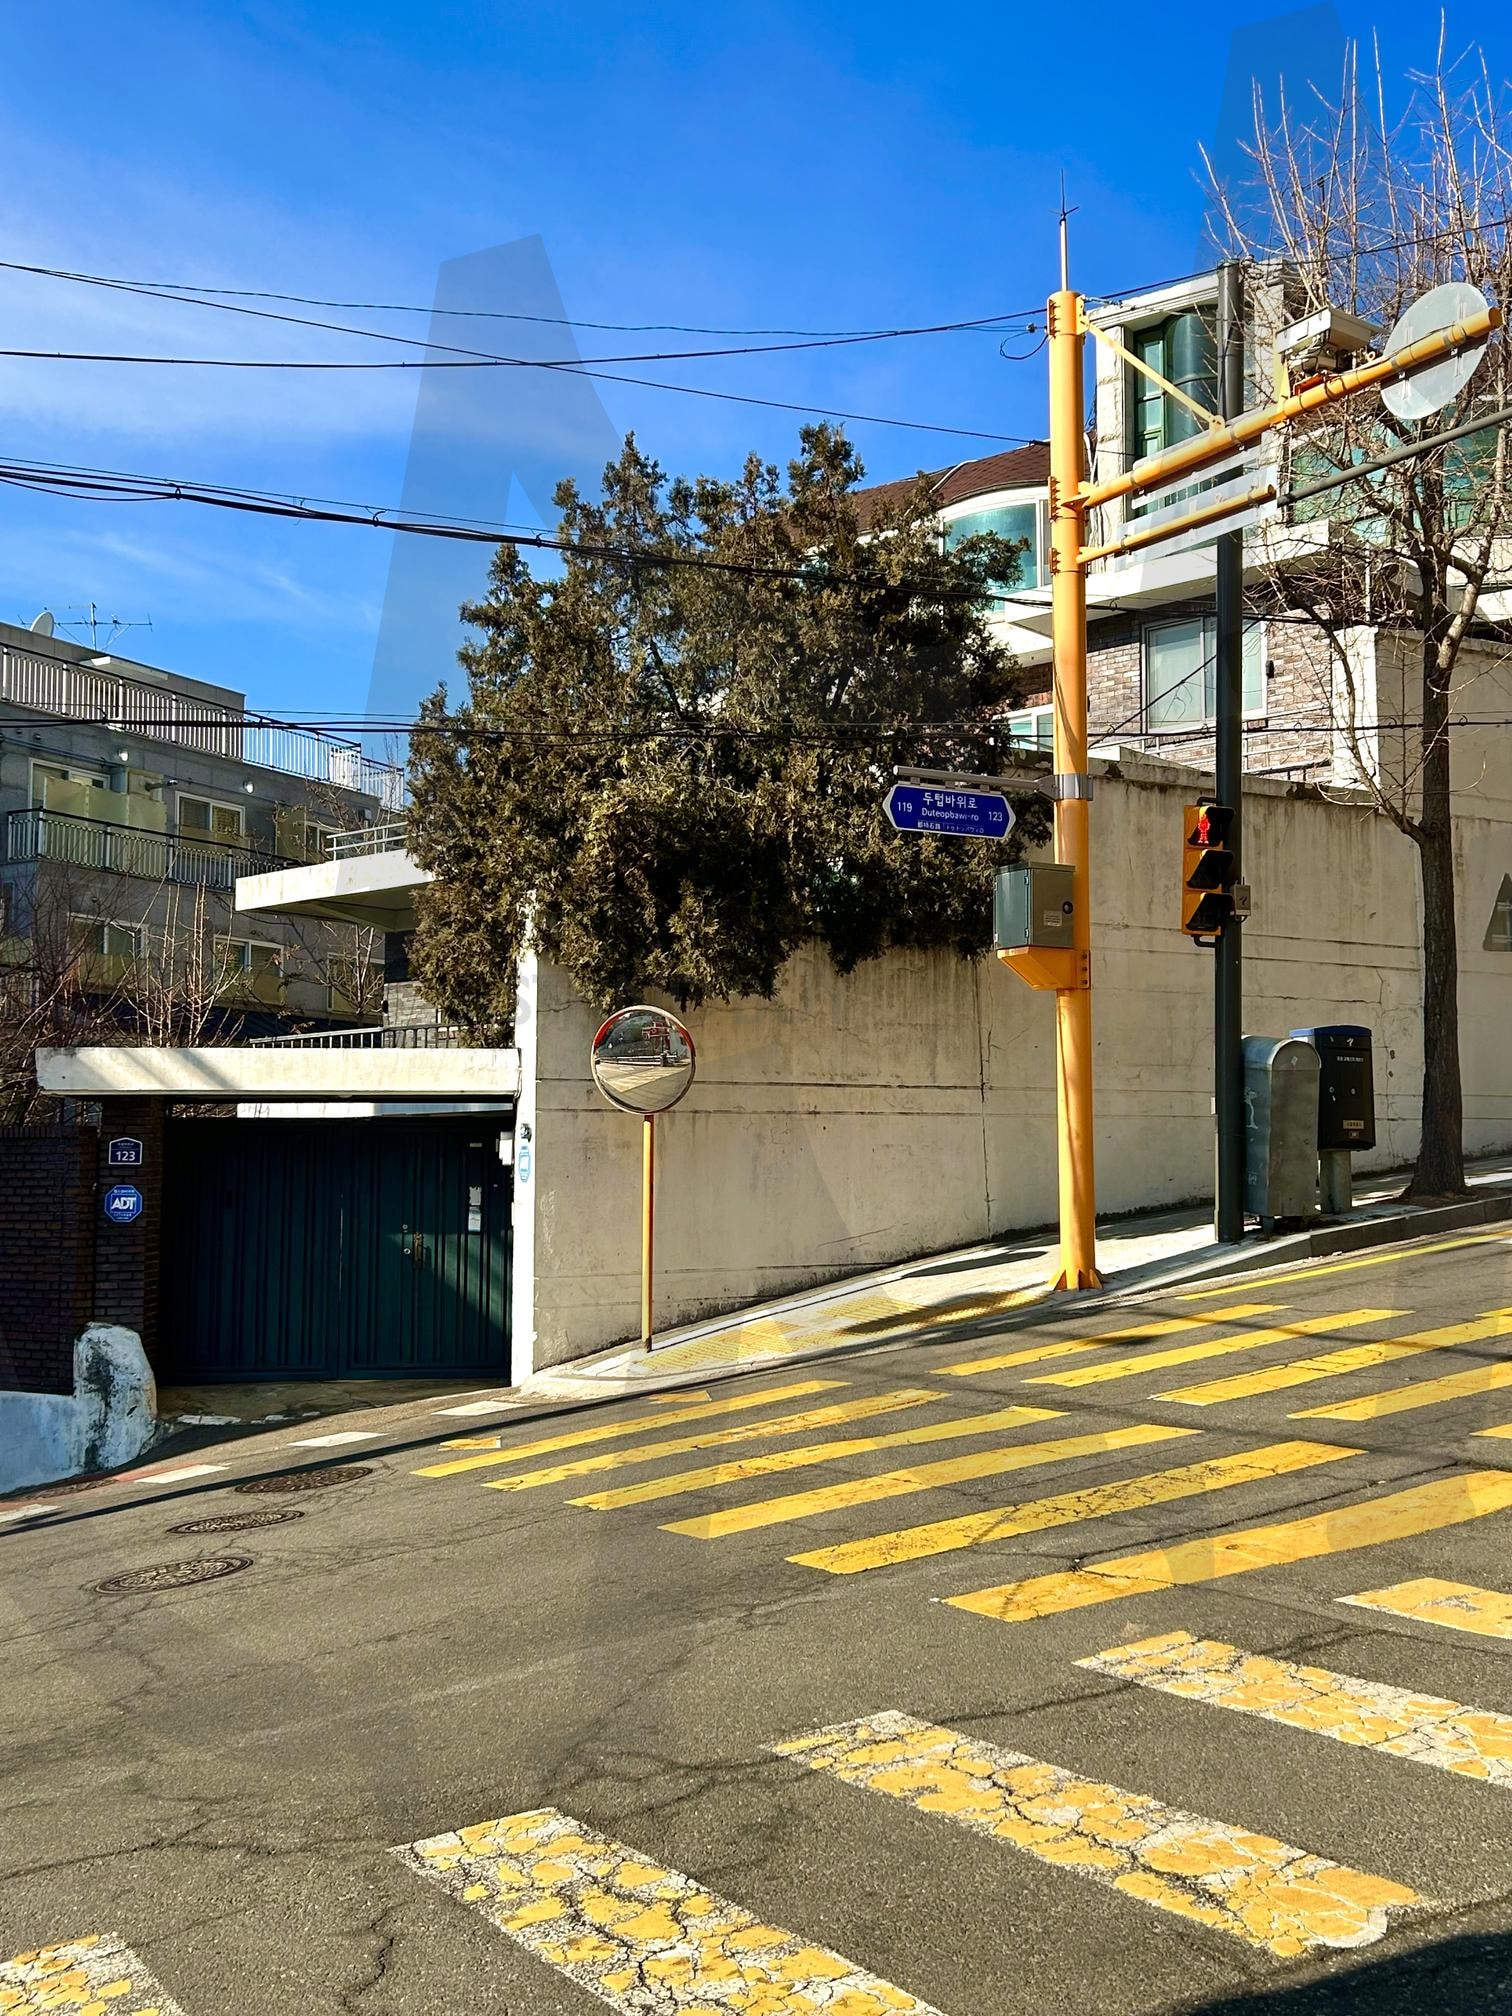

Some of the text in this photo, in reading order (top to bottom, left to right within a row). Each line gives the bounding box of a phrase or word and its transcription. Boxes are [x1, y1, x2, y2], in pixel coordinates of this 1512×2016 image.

[923, 792, 978, 808] 두텁바위로
[896, 801, 913, 813] 119
[921, 807, 980, 821] Duteopbawi-ro
[988, 811, 1003, 822] 123
[116, 1151, 135, 1161] 123
[111, 1197, 136, 1209] ADT
